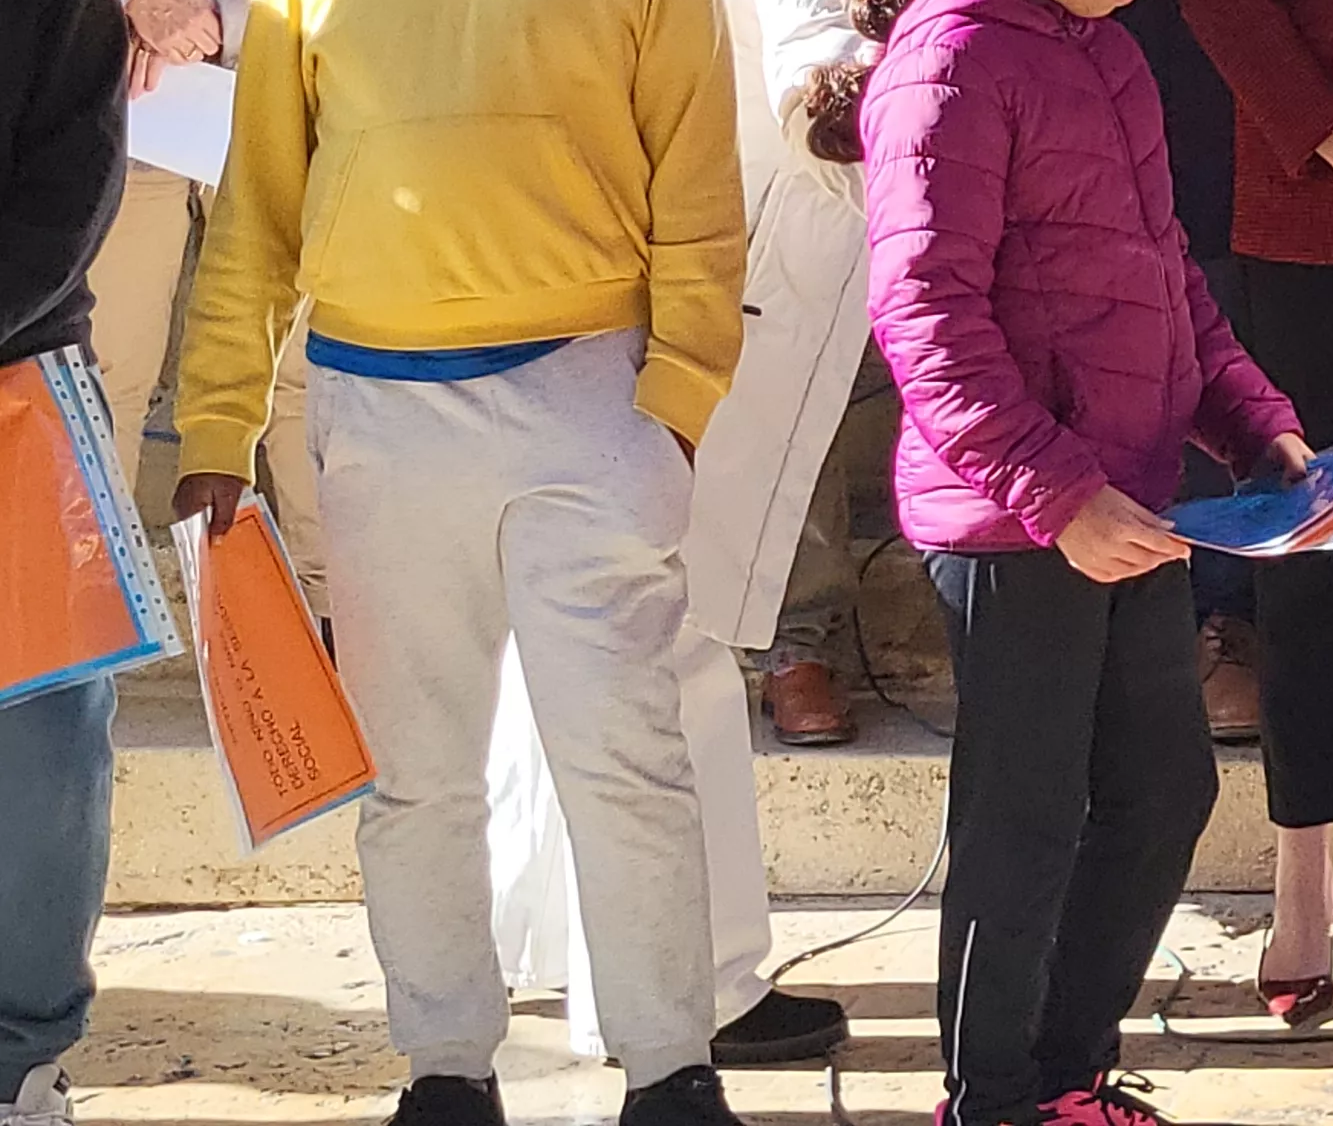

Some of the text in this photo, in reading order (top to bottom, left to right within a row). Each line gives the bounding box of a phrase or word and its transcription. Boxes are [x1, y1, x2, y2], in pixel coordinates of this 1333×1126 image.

[259, 708, 305, 790] DERECHO
[259, 748, 288, 797] TODO
[287, 720, 321, 782] SOCIAL
